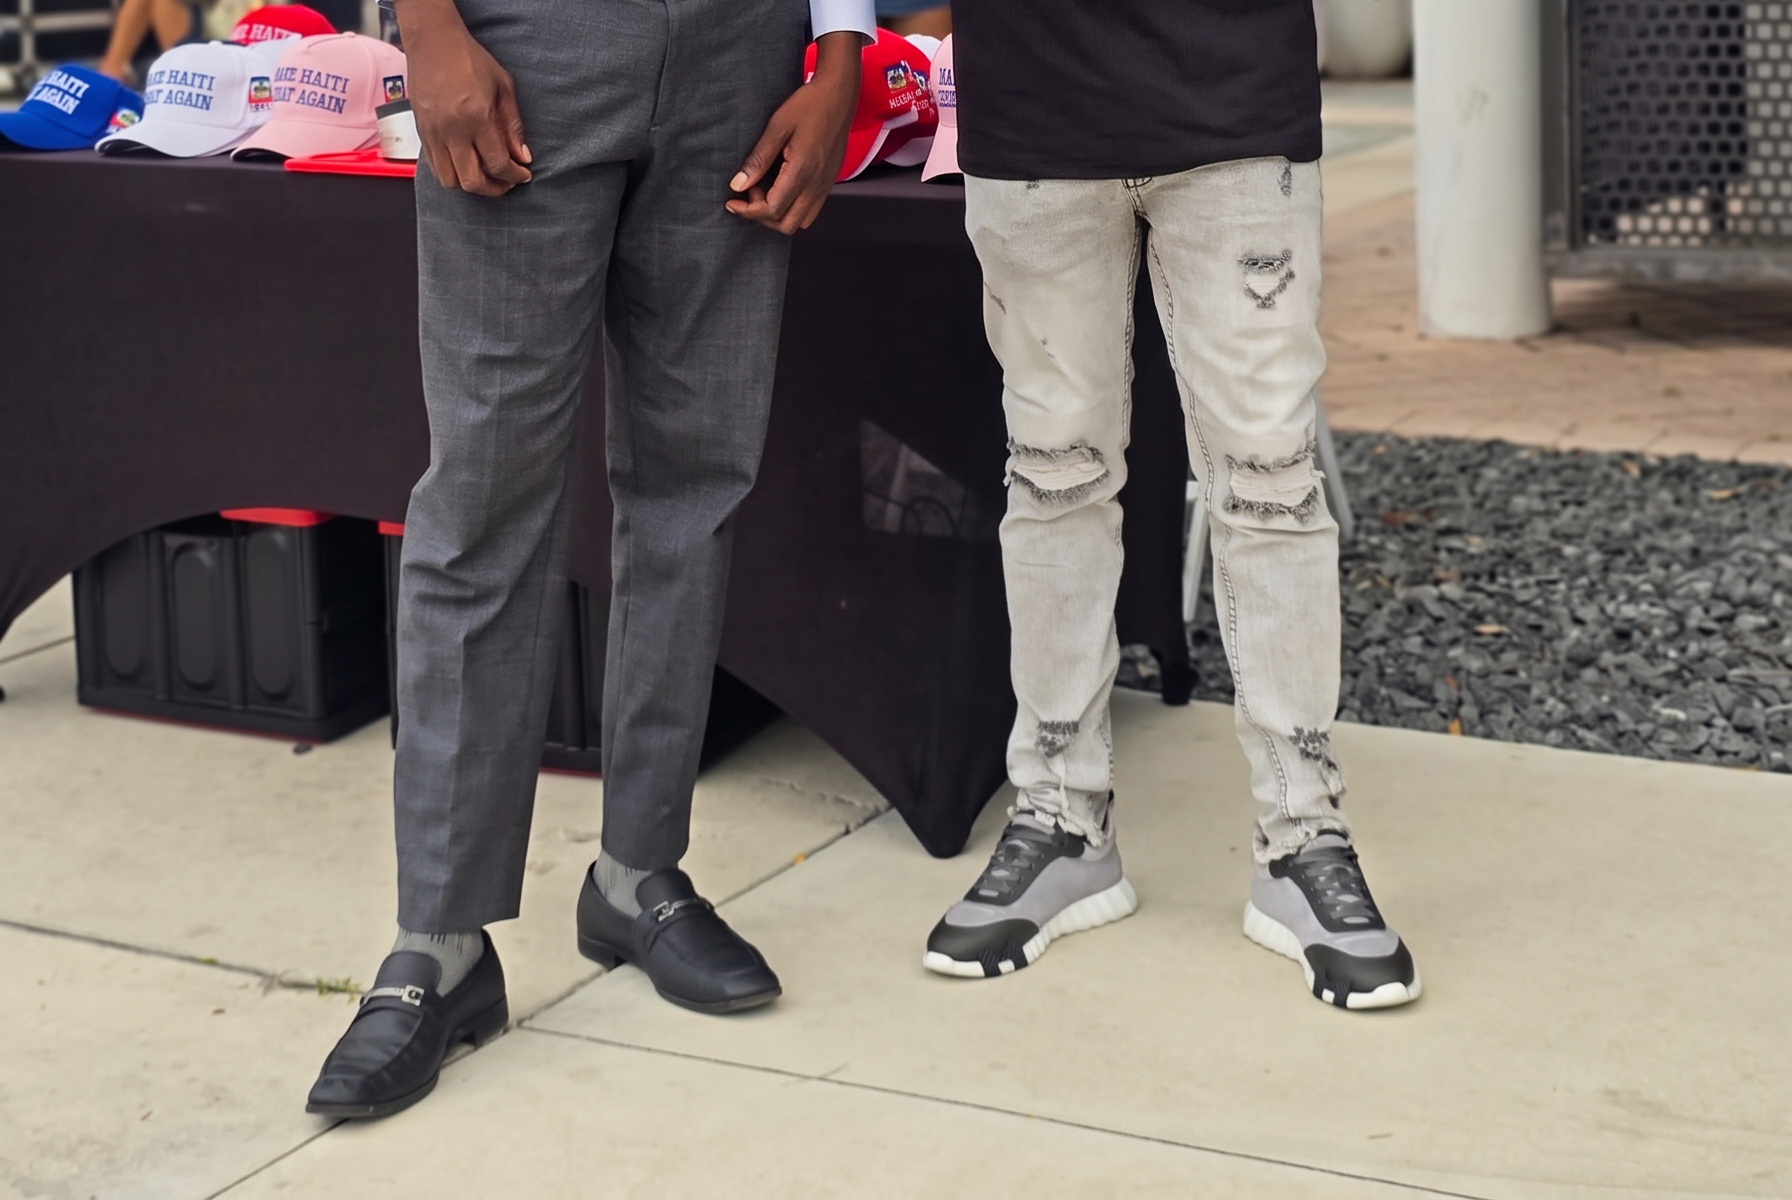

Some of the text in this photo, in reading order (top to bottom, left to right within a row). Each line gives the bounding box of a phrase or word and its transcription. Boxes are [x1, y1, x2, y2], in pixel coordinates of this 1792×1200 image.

[248, 23, 302, 41] HAIT
[45, 69, 90, 99] HAITI
[166, 69, 216, 92] HAITI
[298, 67, 350, 94] HAITI
[33, 86, 81, 115] AGAIN
[163, 89, 214, 111] AGAIN
[295, 87, 347, 115] AGAIN
